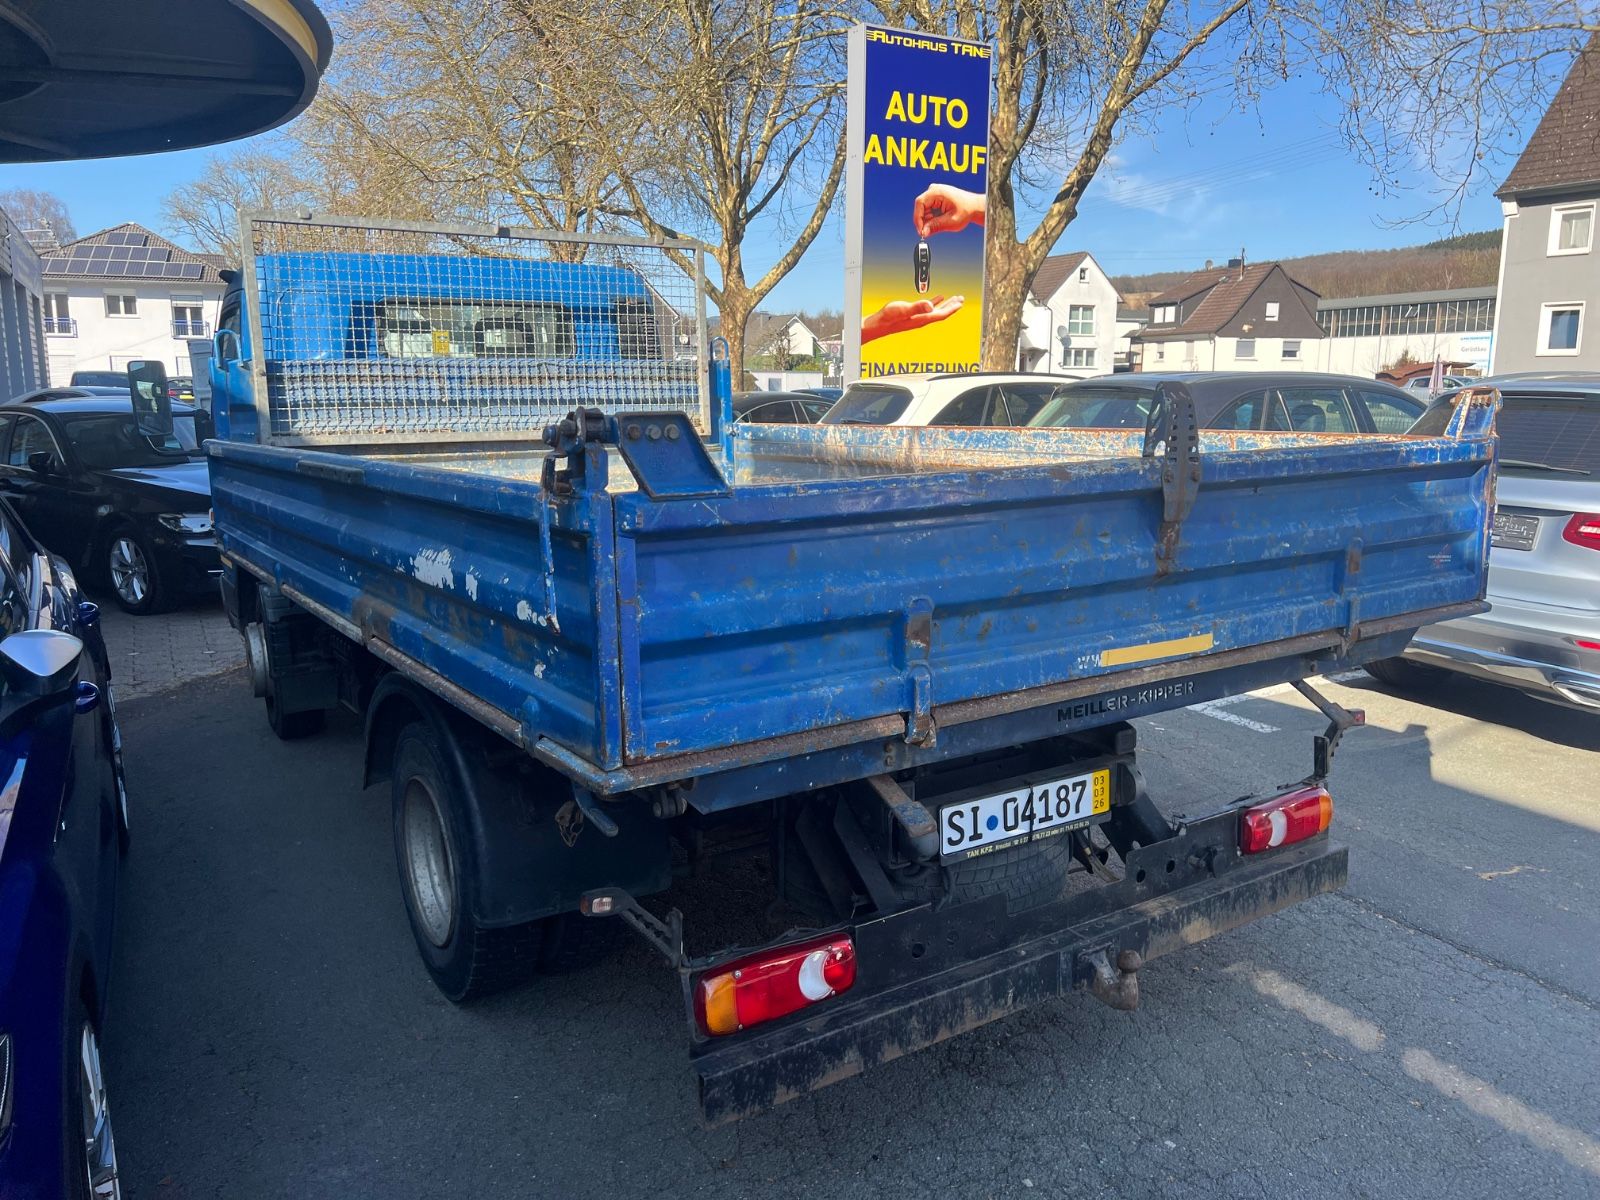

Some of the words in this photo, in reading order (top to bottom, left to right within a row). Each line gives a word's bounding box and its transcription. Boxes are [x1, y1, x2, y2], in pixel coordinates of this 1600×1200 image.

[872, 30, 948, 53] AUTOHAUS
[951, 42, 986, 59] TAN
[885, 90, 969, 129] AUTO
[864, 134, 987, 174] ANKAUF
[1057, 681, 1194, 721] MEILLER-KIPPER
[1094, 775, 1105, 786] 03
[1094, 786, 1105, 797] 03
[947, 805, 983, 846] SI
[1003, 780, 1087, 832] 04187
[1094, 798, 1105, 809] 26
